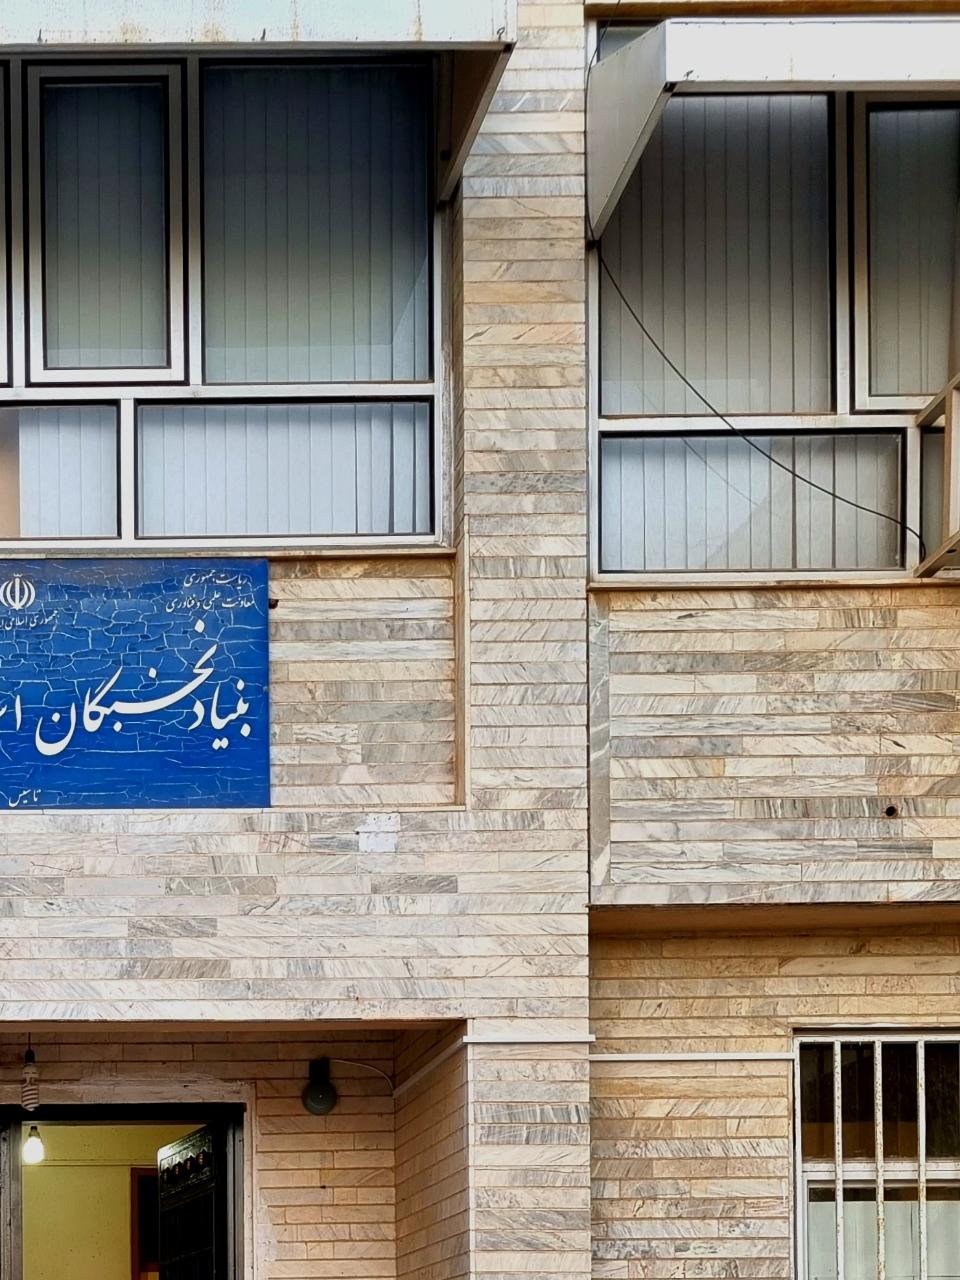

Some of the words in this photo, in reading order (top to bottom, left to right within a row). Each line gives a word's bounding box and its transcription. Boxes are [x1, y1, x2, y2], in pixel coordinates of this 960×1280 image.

[183, 569, 216, 588] جمهوری
[216, 573, 248, 590] ریاست
[165, 594, 195, 613] فناوری
[202, 590, 221, 610] علمی
[221, 597, 255, 608] معاونت
[4, 615, 28, 630] اسلامی
[29, 610, 59, 627] جمهوری
[34, 619, 218, 756] نخبگان
[188, 679, 251, 750] بنیاد
